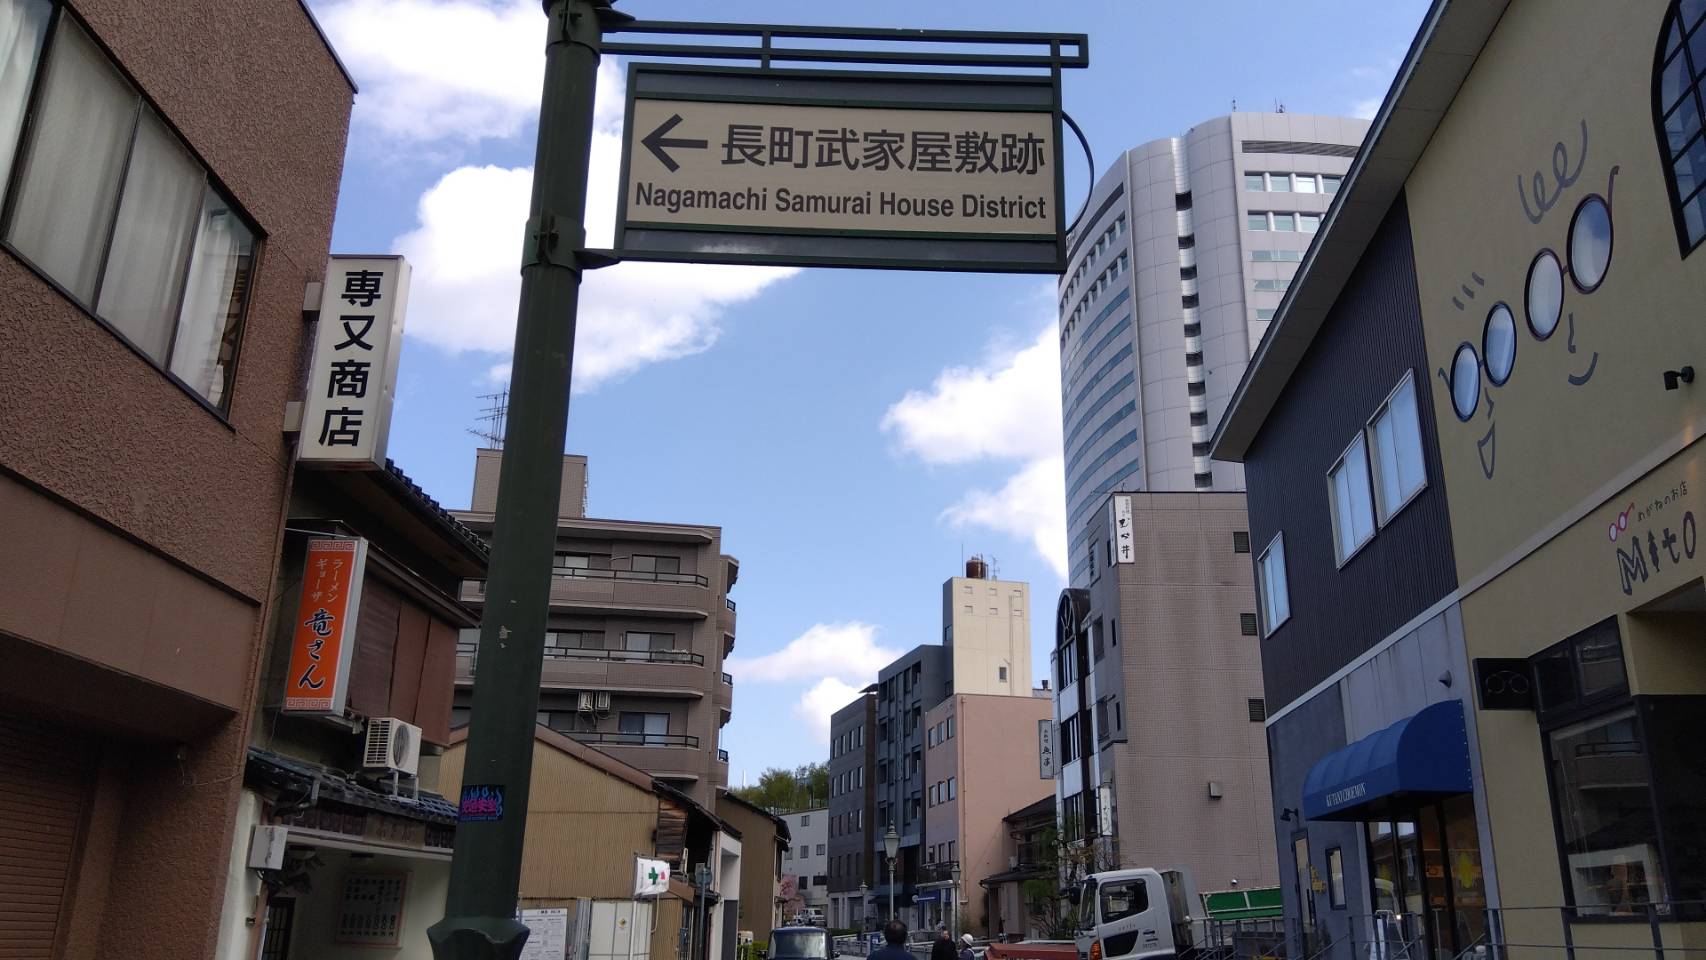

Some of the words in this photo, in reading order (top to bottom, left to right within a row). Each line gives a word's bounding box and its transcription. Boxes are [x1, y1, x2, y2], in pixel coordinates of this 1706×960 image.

[720, 123, 1046, 176] 長町武家屋敷跡
[635, 182, 767, 214] Nagamachi
[775, 188, 871, 215] Samurai
[879, 191, 954, 218] House
[961, 193, 1047, 219] District
[318, 269, 384, 447] 専又商店
[311, 558, 329, 603] ギョーザ
[327, 558, 344, 603] ラーメン
[298, 607, 336, 690] 竜さん
